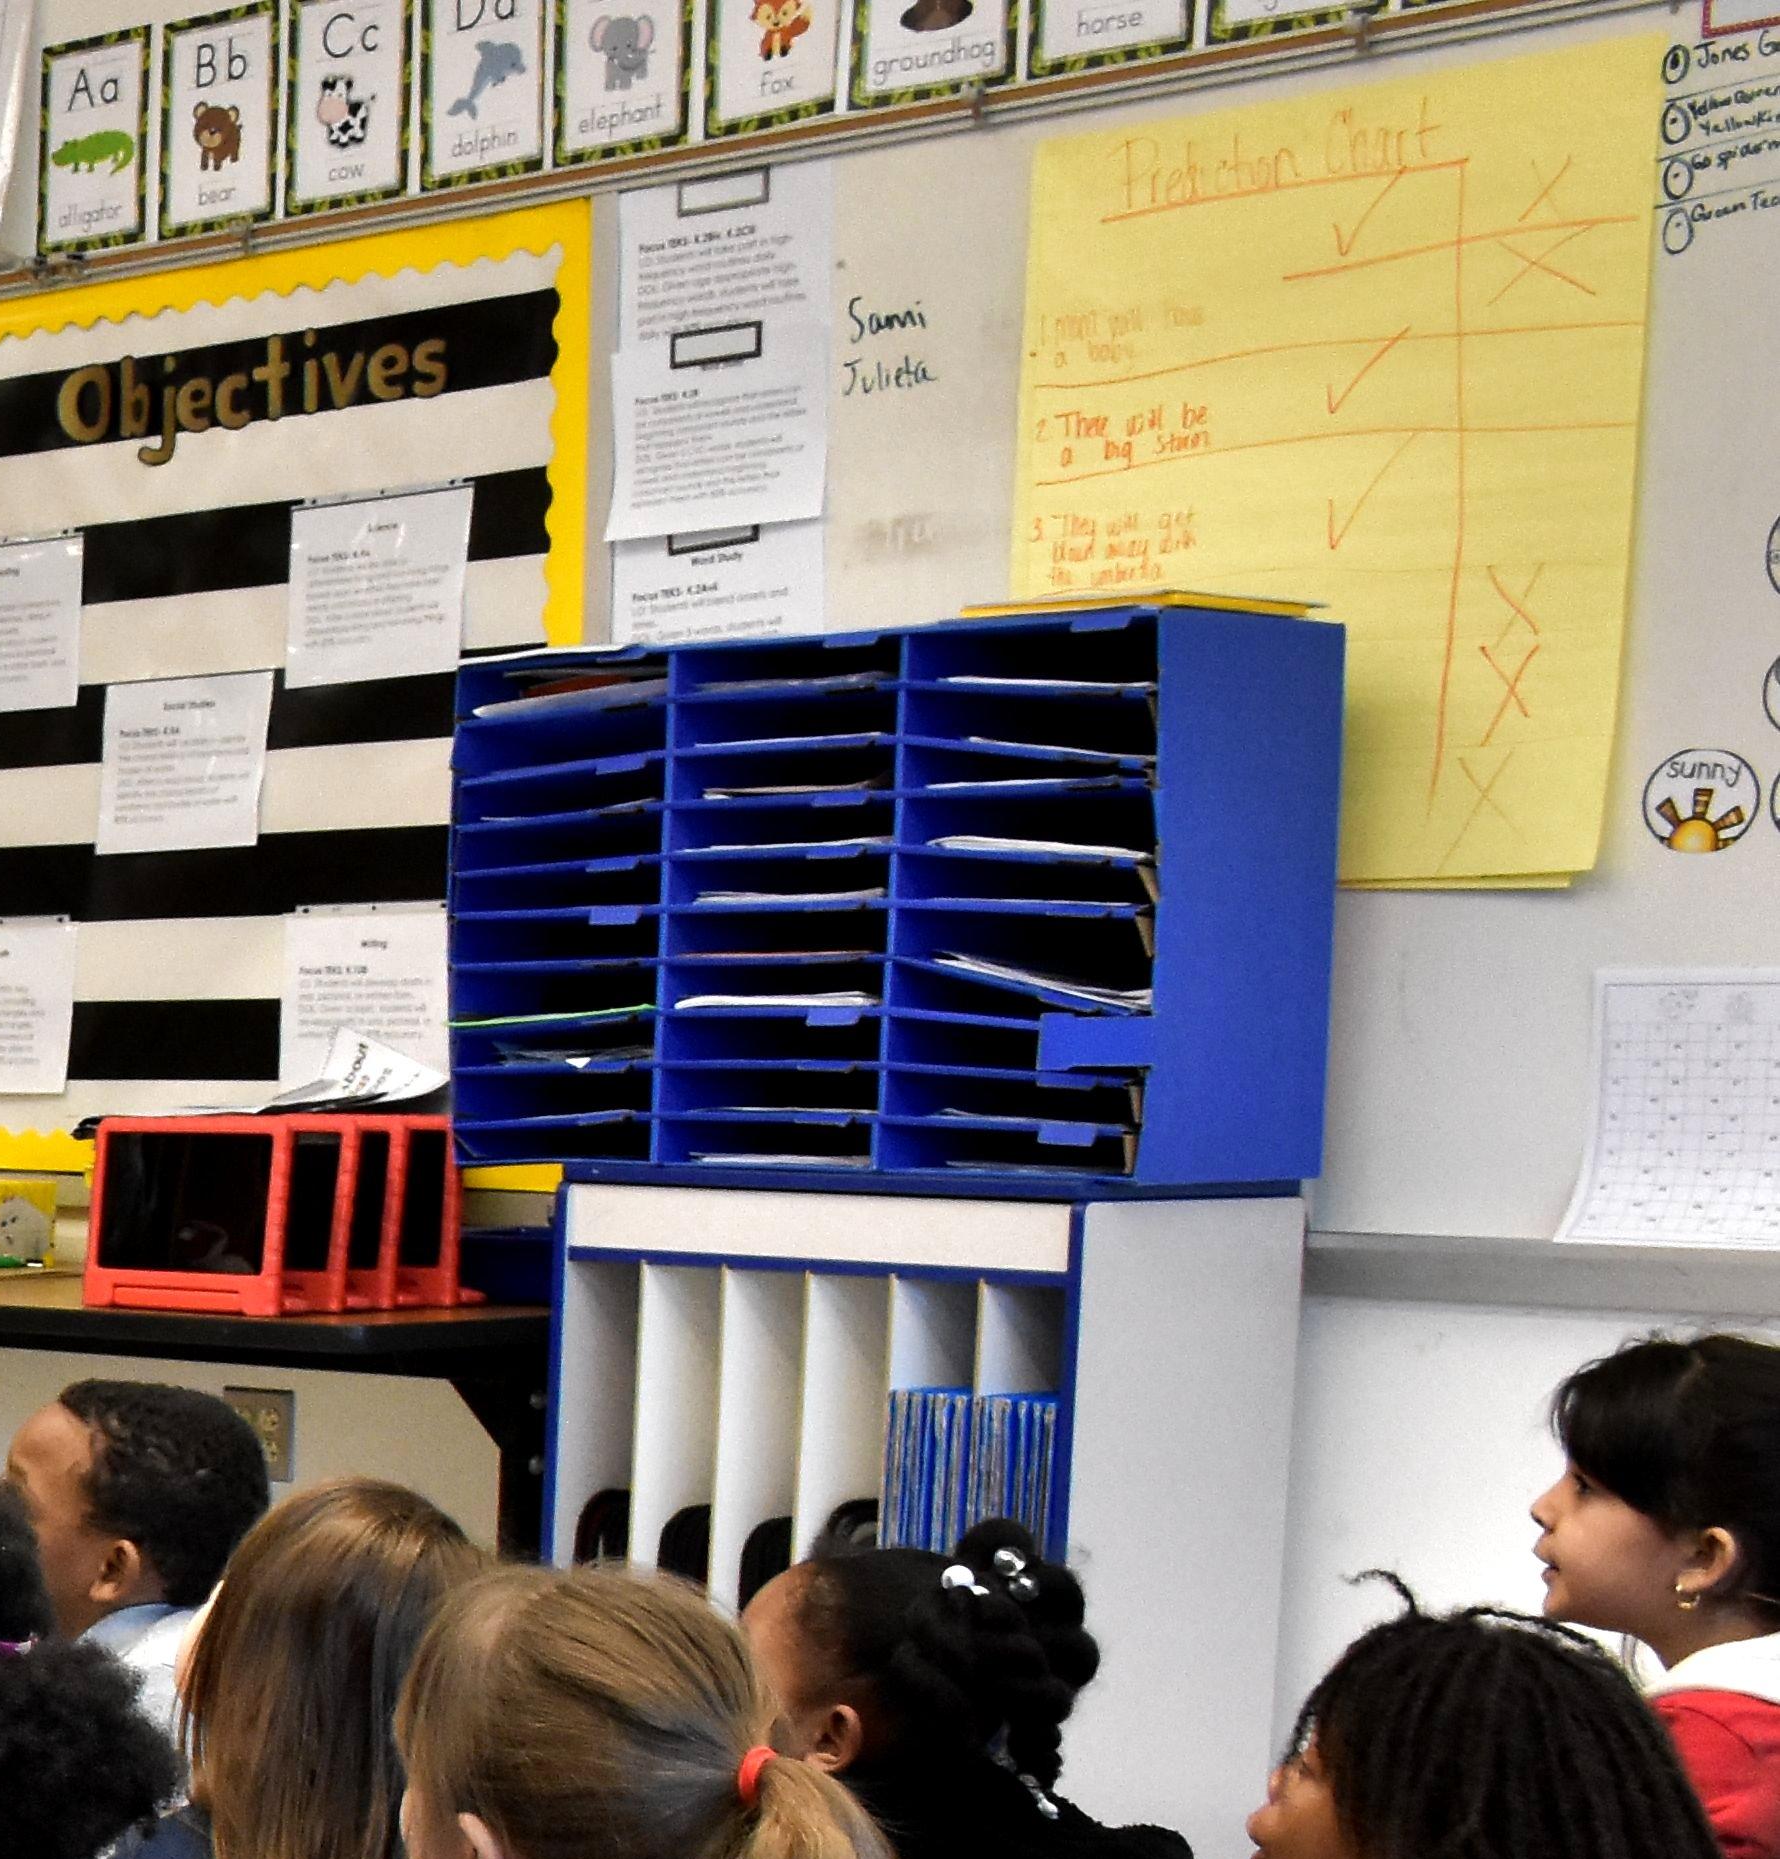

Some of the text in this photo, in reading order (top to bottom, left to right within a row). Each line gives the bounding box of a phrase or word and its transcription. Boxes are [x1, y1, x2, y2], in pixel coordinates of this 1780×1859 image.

[1076, 9, 1143, 38] horse
[872, 40, 997, 90] groundhog
[1694, 41, 1750, 68] Jones
[759, 70, 796, 96] fox
[578, 99, 665, 137] elephant
[450, 127, 520, 159] dolphin
[1121, 96, 1445, 209] Prediction Chart
[328, 162, 365, 181] cow
[198, 185, 236, 206] bear
[58, 202, 123, 233] alligator
[1691, 202, 1746, 222] Green
[842, 359, 938, 397] Julieta
[57, 328, 448, 466] Objectives
[1182, 402, 1207, 429] be
[1666, 759, 1741, 789] sunny
